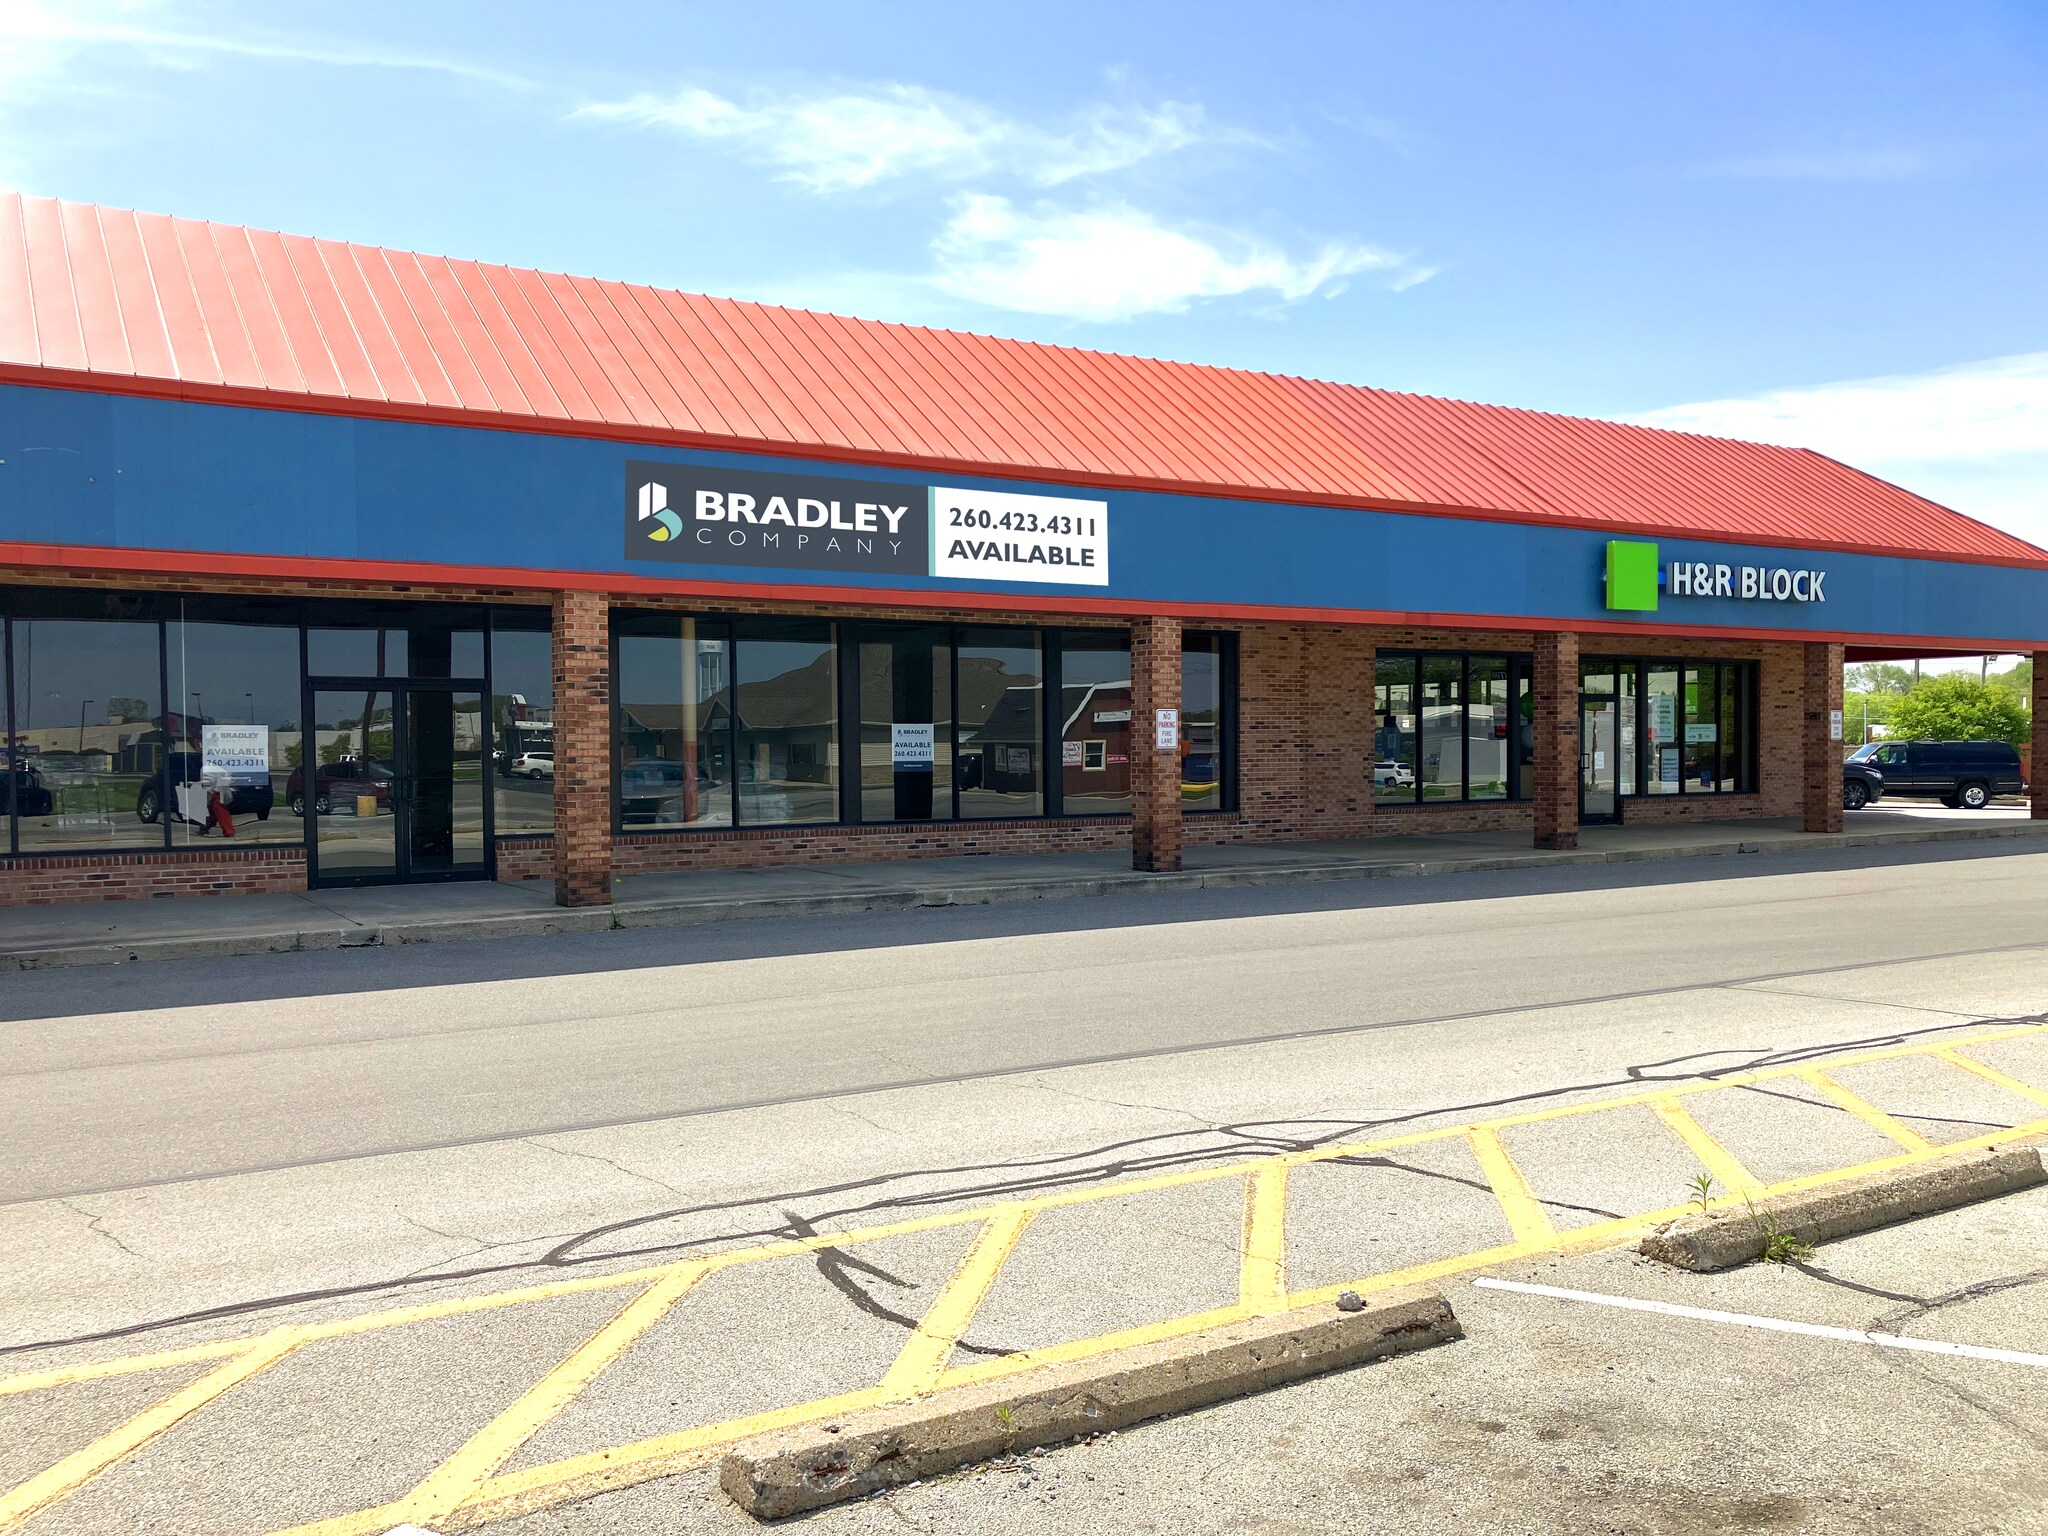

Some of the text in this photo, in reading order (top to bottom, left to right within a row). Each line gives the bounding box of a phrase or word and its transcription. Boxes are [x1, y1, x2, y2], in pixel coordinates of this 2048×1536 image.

[695, 489, 909, 534] BRADLEY
[949, 507, 1095, 537] 260.423.4311
[696, 528, 902, 556] COMPANY
[948, 539, 1095, 567] AVAILABLE
[1673, 562, 1826, 602] H&R BLOCK
[207, 748, 265, 756] AVAILABLE
[207, 759, 264, 767] 260.423.4311
